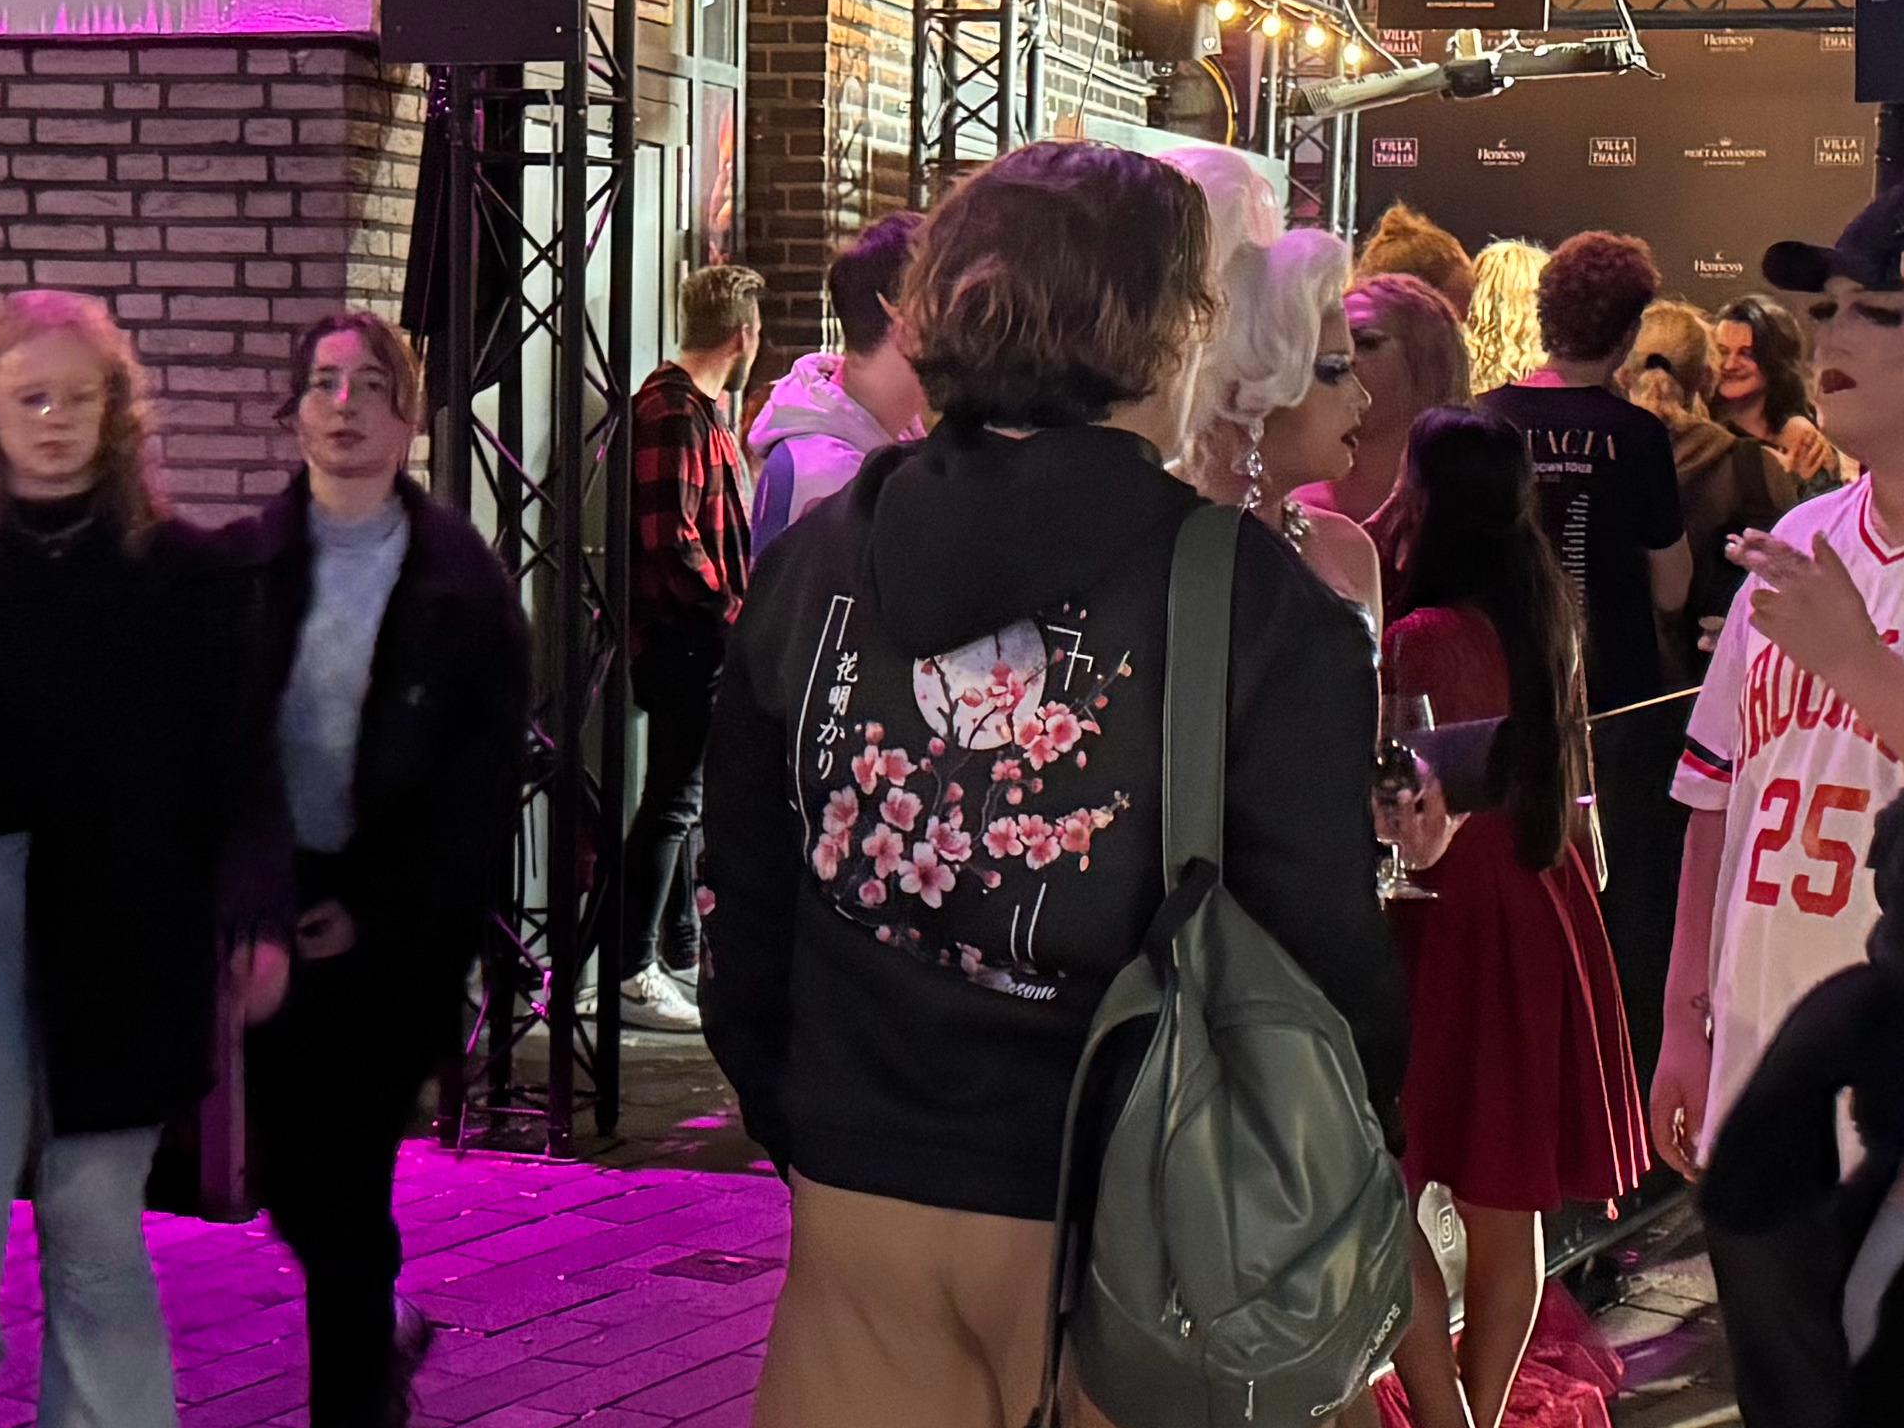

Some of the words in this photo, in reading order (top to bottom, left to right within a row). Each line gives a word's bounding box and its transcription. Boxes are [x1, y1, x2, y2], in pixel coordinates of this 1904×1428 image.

[1380, 141, 1412, 151] VILLA
[1597, 140, 1629, 150] VILLA
[1823, 139, 1857, 149] VILLA
[1593, 153, 1634, 164] THALIA
[1819, 151, 1861, 163] THALIA
[1746, 778, 1871, 918] 25
